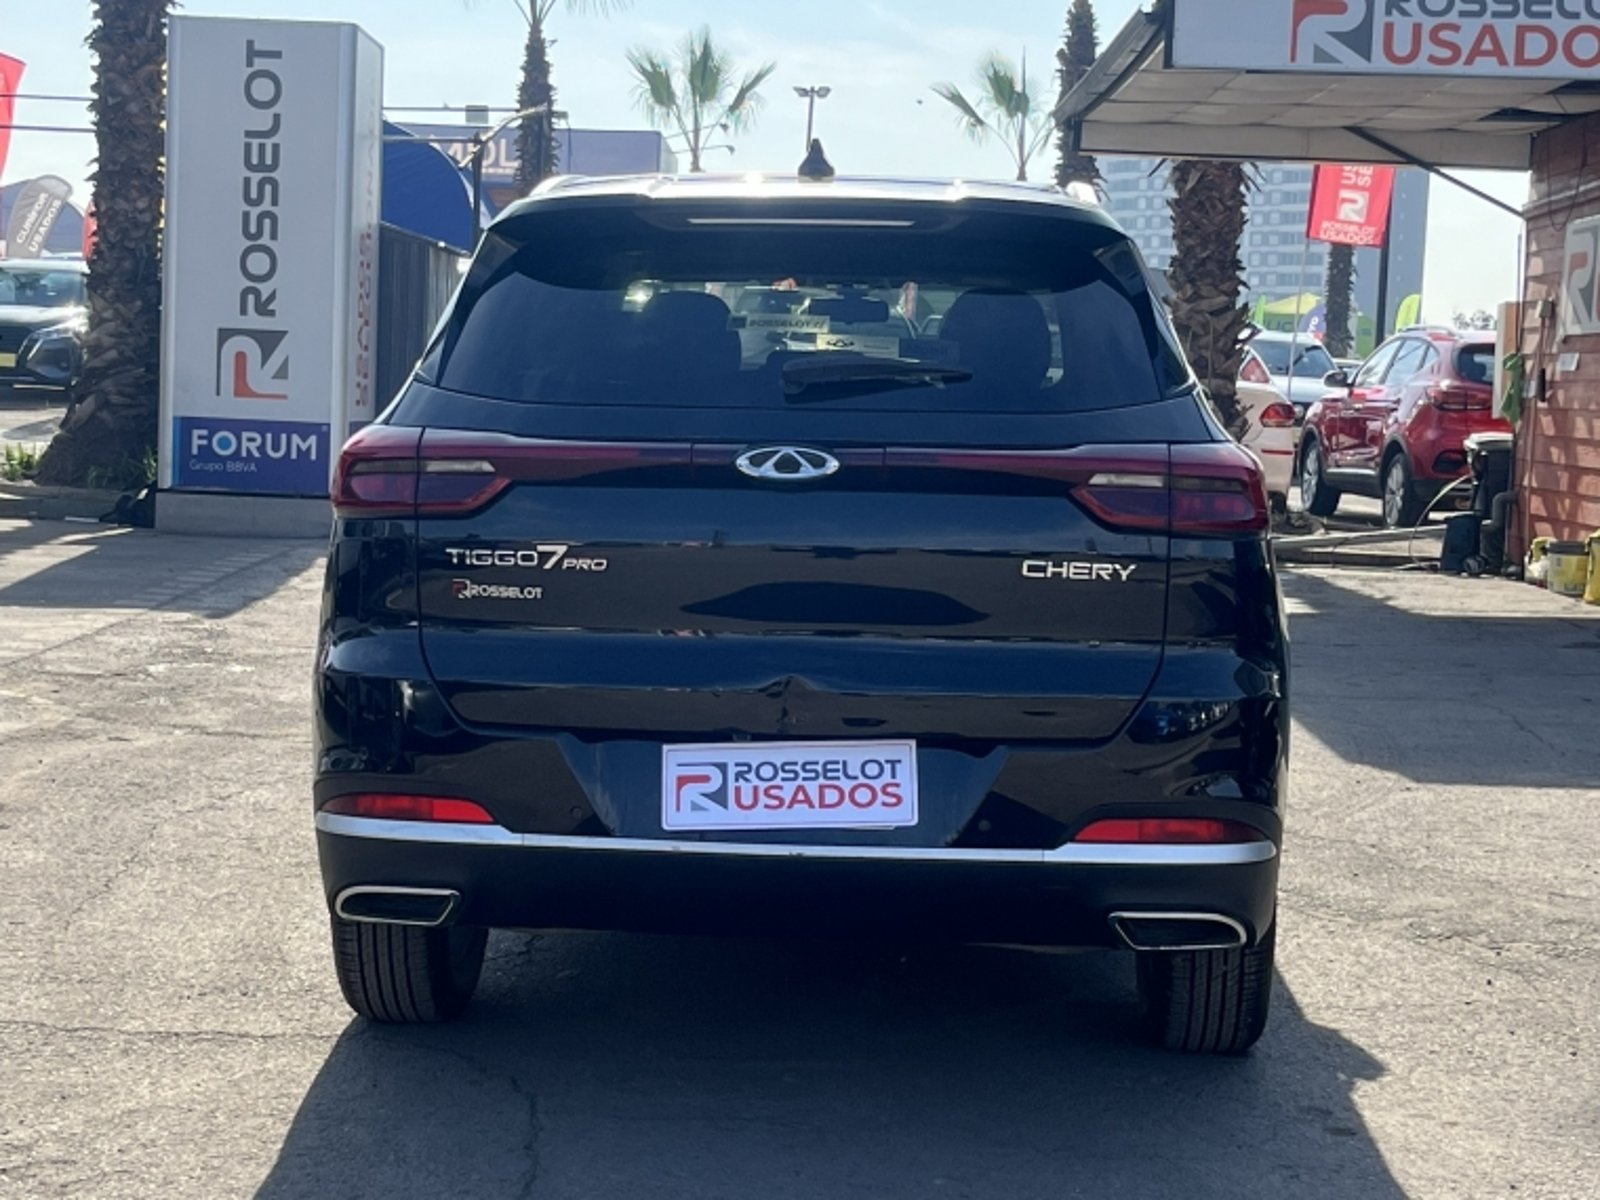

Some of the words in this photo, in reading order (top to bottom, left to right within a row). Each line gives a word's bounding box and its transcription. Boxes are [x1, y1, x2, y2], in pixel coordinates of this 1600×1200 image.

[239, 39, 283, 318] ROSSELOT
[190, 428, 318, 461] FORUM
[188, 459, 224, 472] Grupo
[225, 460, 258, 472] BBVA
[1022, 559, 1138, 582] CHERY
[470, 584, 543, 600] ROSSELOT
[733, 758, 903, 783] ROSSELOT
[733, 782, 904, 812] USADOS
